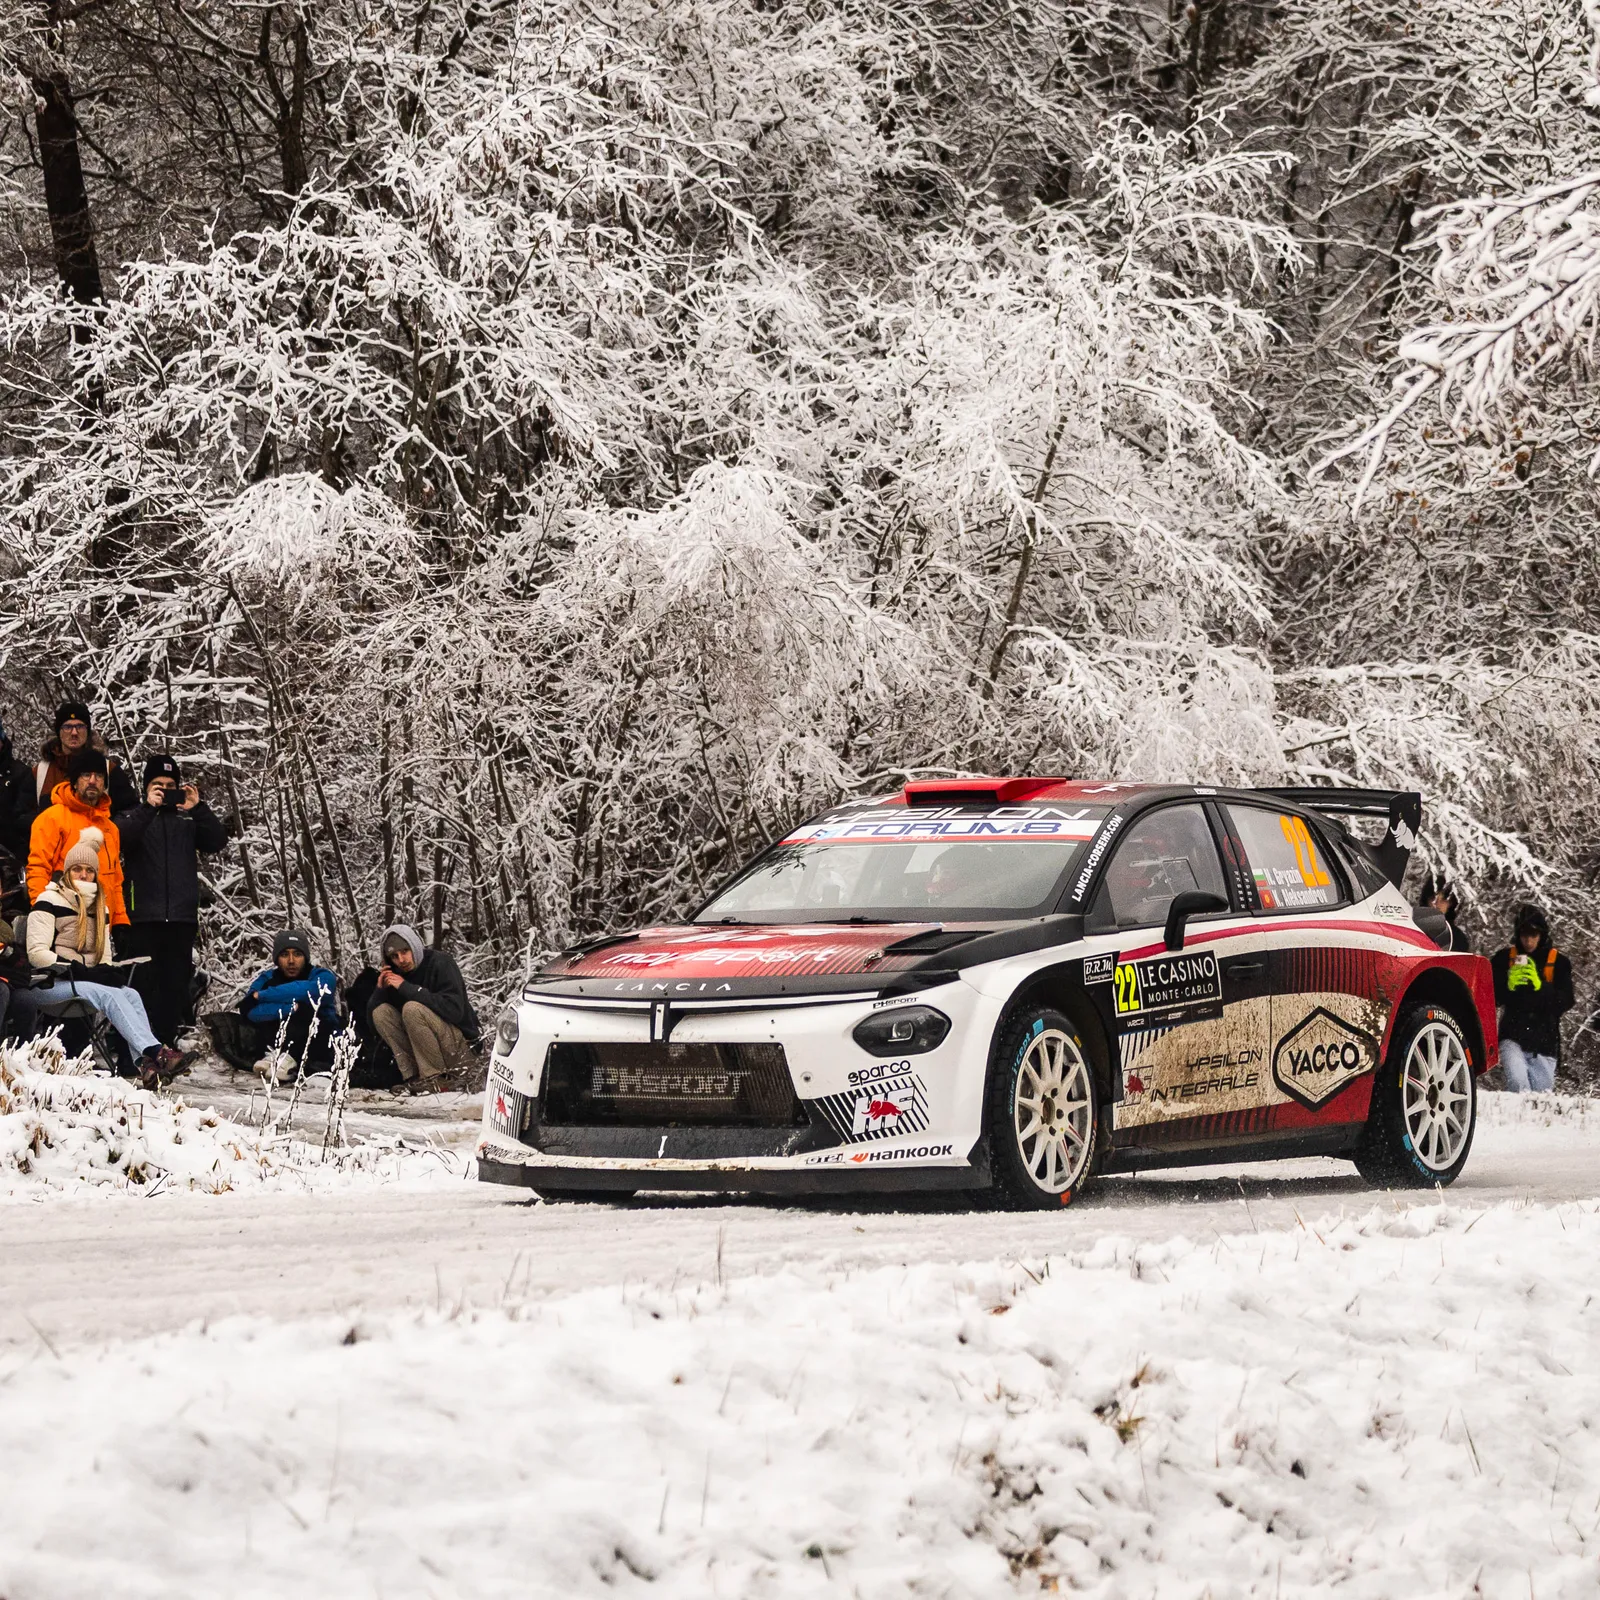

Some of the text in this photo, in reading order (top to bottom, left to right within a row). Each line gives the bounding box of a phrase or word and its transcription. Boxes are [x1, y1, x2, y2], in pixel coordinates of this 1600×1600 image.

[823, 806, 1092, 824] YPSILON
[842, 821, 1062, 836] FORUM8
[1071, 814, 1124, 903] LANCIA-CORSEHF.COM
[1279, 815, 1331, 888] 22
[1139, 956, 1216, 988] LE CASINO
[614, 982, 732, 992] LANCIA
[1114, 963, 1140, 1013] 22
[848, 1059, 912, 1086] sparco
[1186, 1048, 1264, 1073] YPSILON
[1288, 1041, 1360, 1076] YACCO
[592, 1066, 751, 1094] PHSPORT
[1150, 1072, 1260, 1103] INTEGRALE
